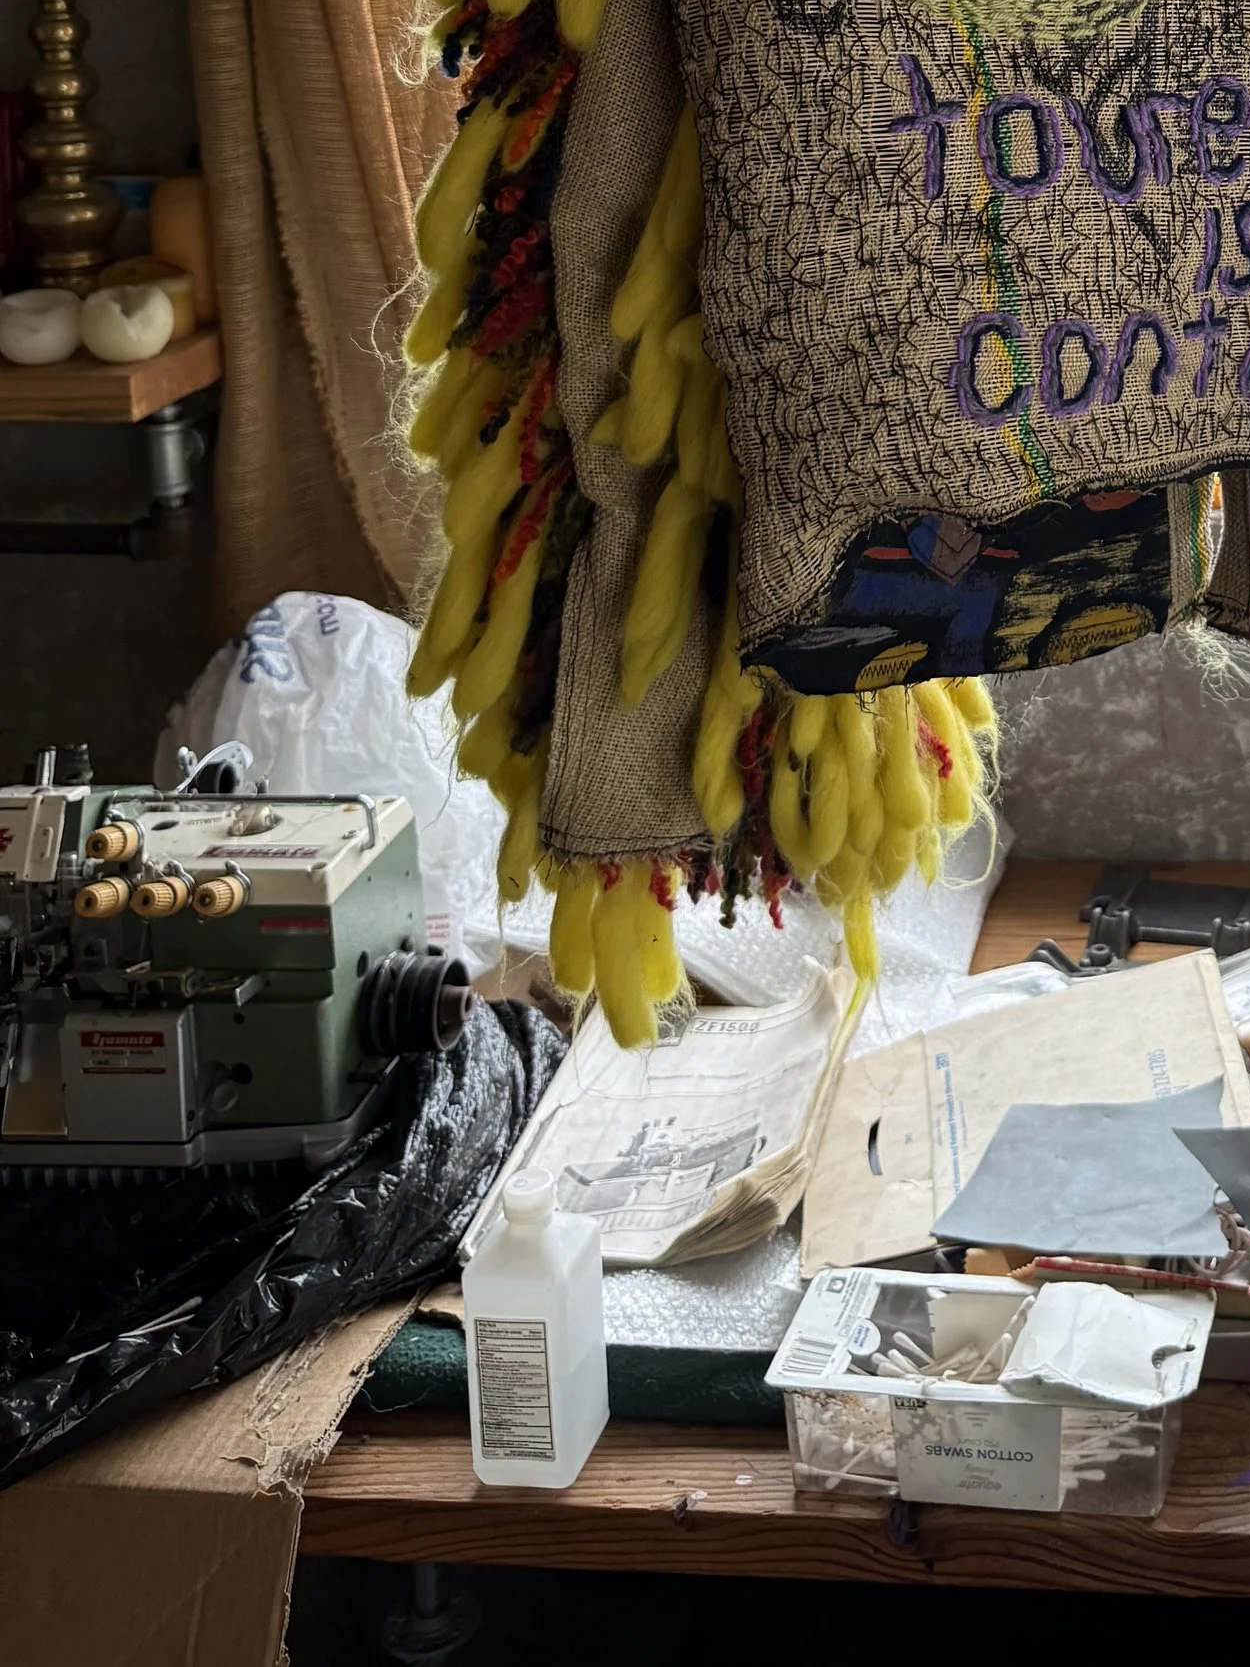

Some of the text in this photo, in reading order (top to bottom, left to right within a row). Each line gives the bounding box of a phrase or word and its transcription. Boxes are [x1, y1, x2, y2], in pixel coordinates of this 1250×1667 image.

[695, 1020, 761, 1033] ZF1500
[895, 1398, 919, 1408] USA
[925, 1445, 1034, 1462] COTTON SWABS
